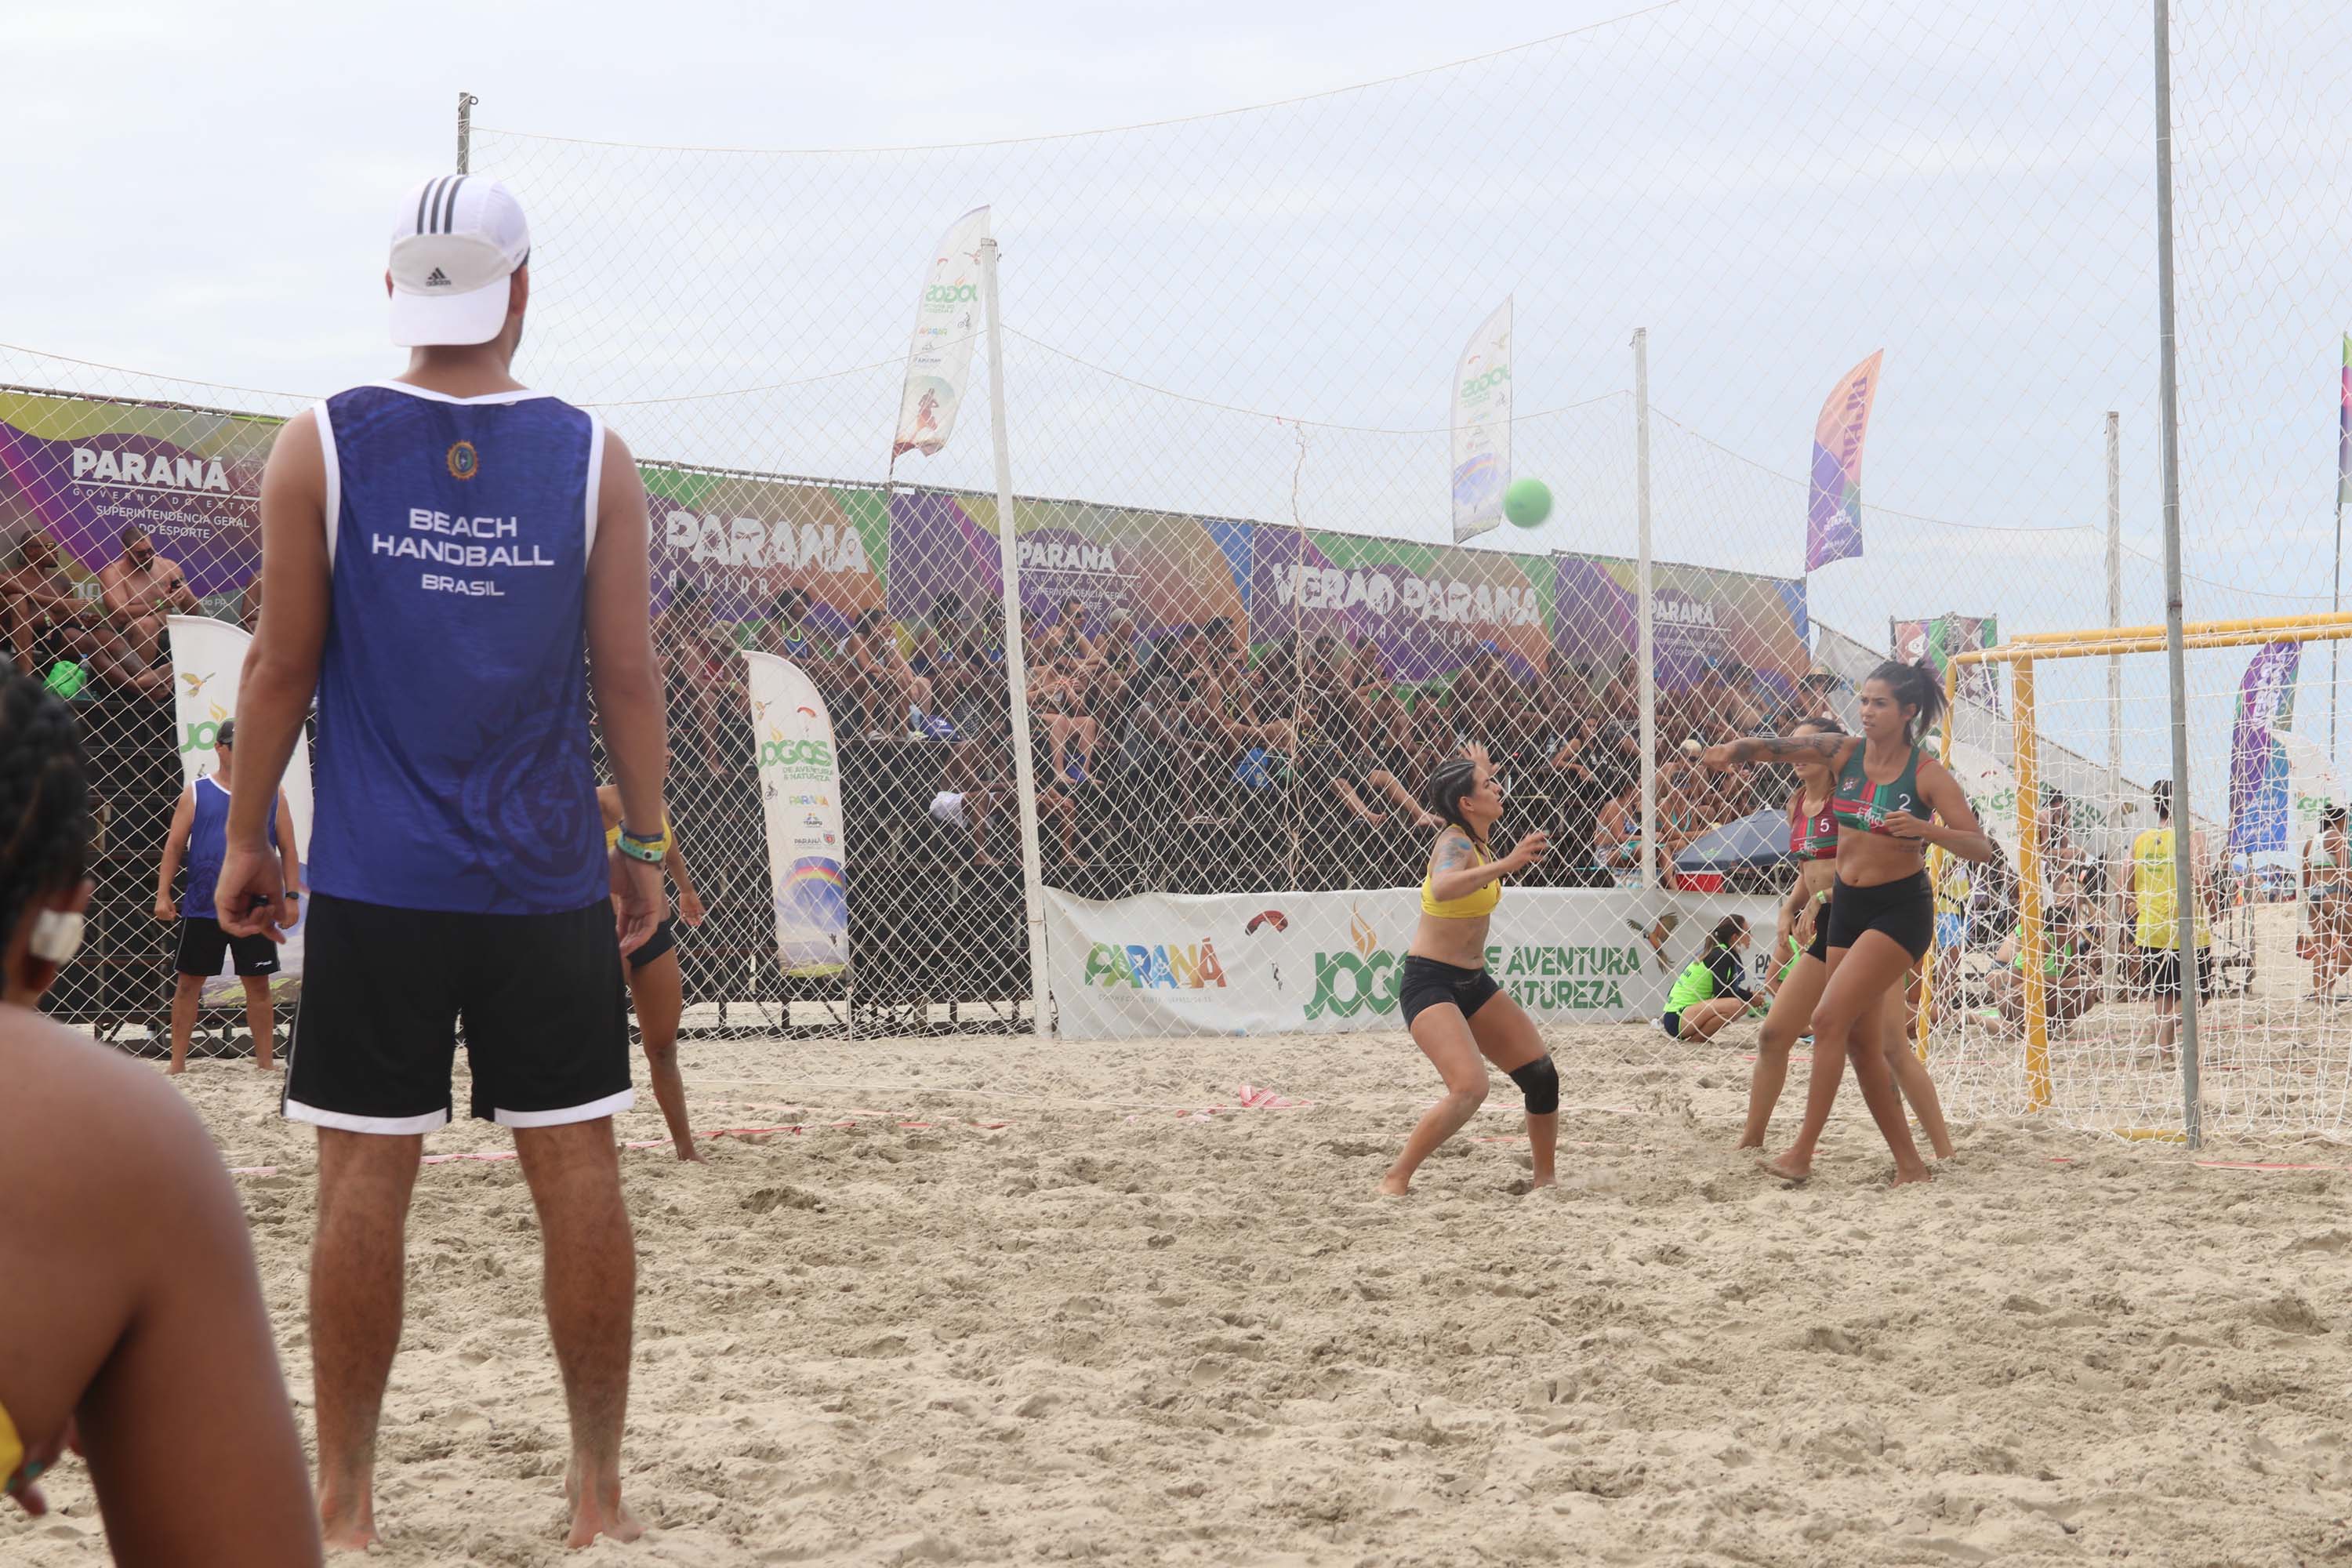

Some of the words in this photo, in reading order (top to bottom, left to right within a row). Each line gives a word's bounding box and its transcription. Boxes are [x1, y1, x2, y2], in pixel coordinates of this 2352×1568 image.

[73, 448, 230, 492] PARANÁ
[73, 488, 158, 503] GOVERNO
[172, 496, 194, 506] DO
[206, 498, 258, 513] ESTAD
[159, 524, 210, 539] ESPORTE
[213, 515, 250, 528] GERAL
[409, 507, 517, 539] BEACH
[372, 533, 554, 567] HANDBALL
[1017, 541, 1118, 571] PARANÁ
[421, 573, 505, 596] BRASIL
[1341, 620, 1387, 639] VIVA
[758, 739, 833, 770] JOGOS
[1898, 793, 1911, 812] 2
[1820, 818, 1830, 833] 5
[1084, 936, 1227, 989] PARANÁ
[1505, 946, 1642, 976] AVENTURA
